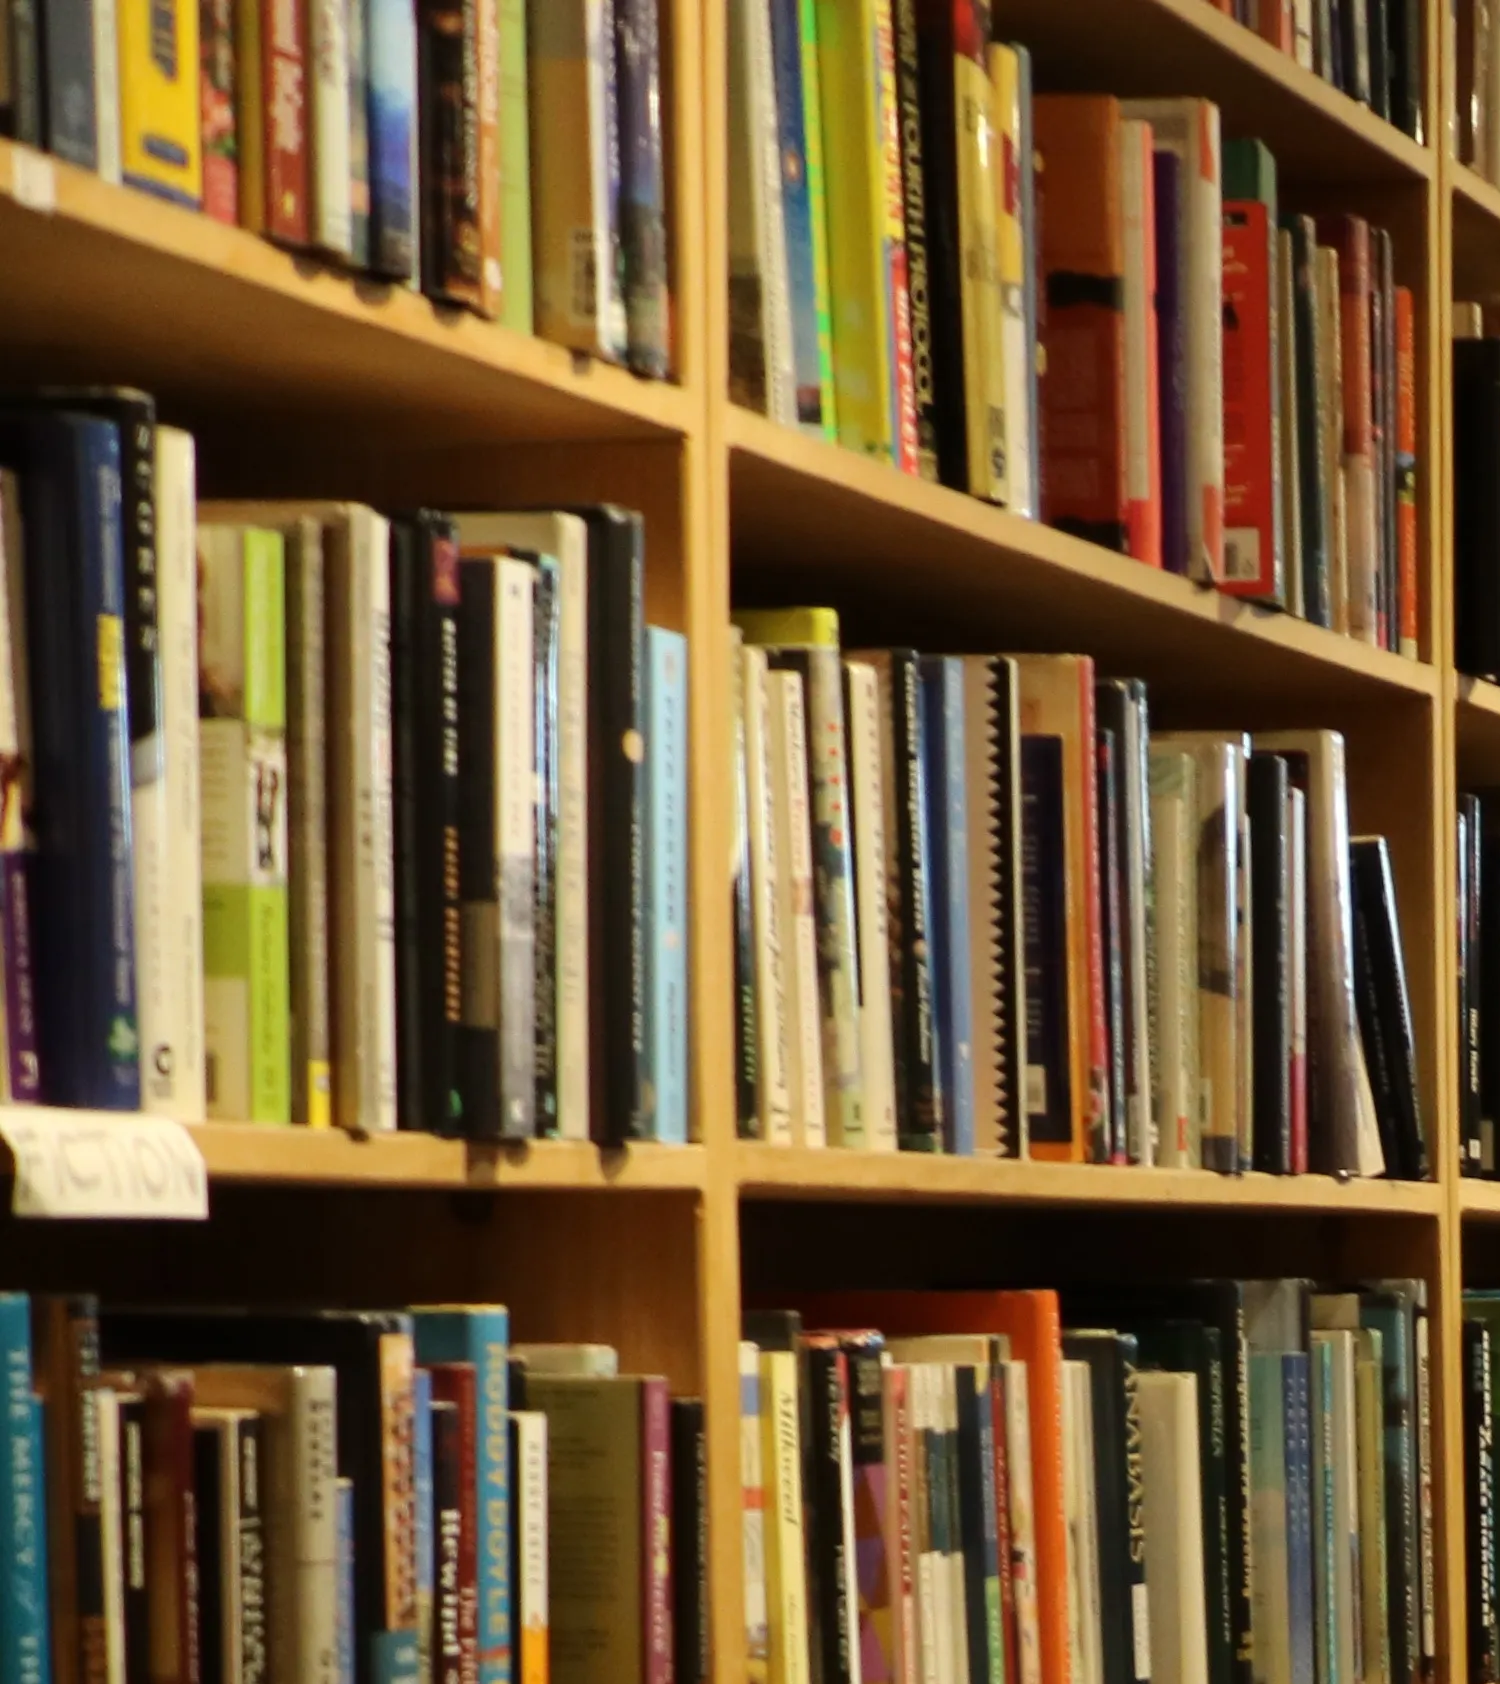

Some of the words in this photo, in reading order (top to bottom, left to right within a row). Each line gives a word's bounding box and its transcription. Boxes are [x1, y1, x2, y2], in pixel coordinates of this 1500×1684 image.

[904, 100, 925, 235] FOURTH
[909, 242, 934, 404] PROTOCOL
[14, 1126, 204, 1200] FICTION
[8, 1349, 31, 1420] THE
[486, 1343, 509, 1489] RODDY
[12, 1436, 35, 1567] MERCY
[778, 1390, 800, 1525] Milkweed
[1121, 1361, 1146, 1562] ANABASIS
[442, 1510, 462, 1656] Rewind
[461, 1587, 478, 1635] The
[487, 1500, 509, 1635] DOYLE
[1479, 1512, 1491, 1627] HIGHWATER
